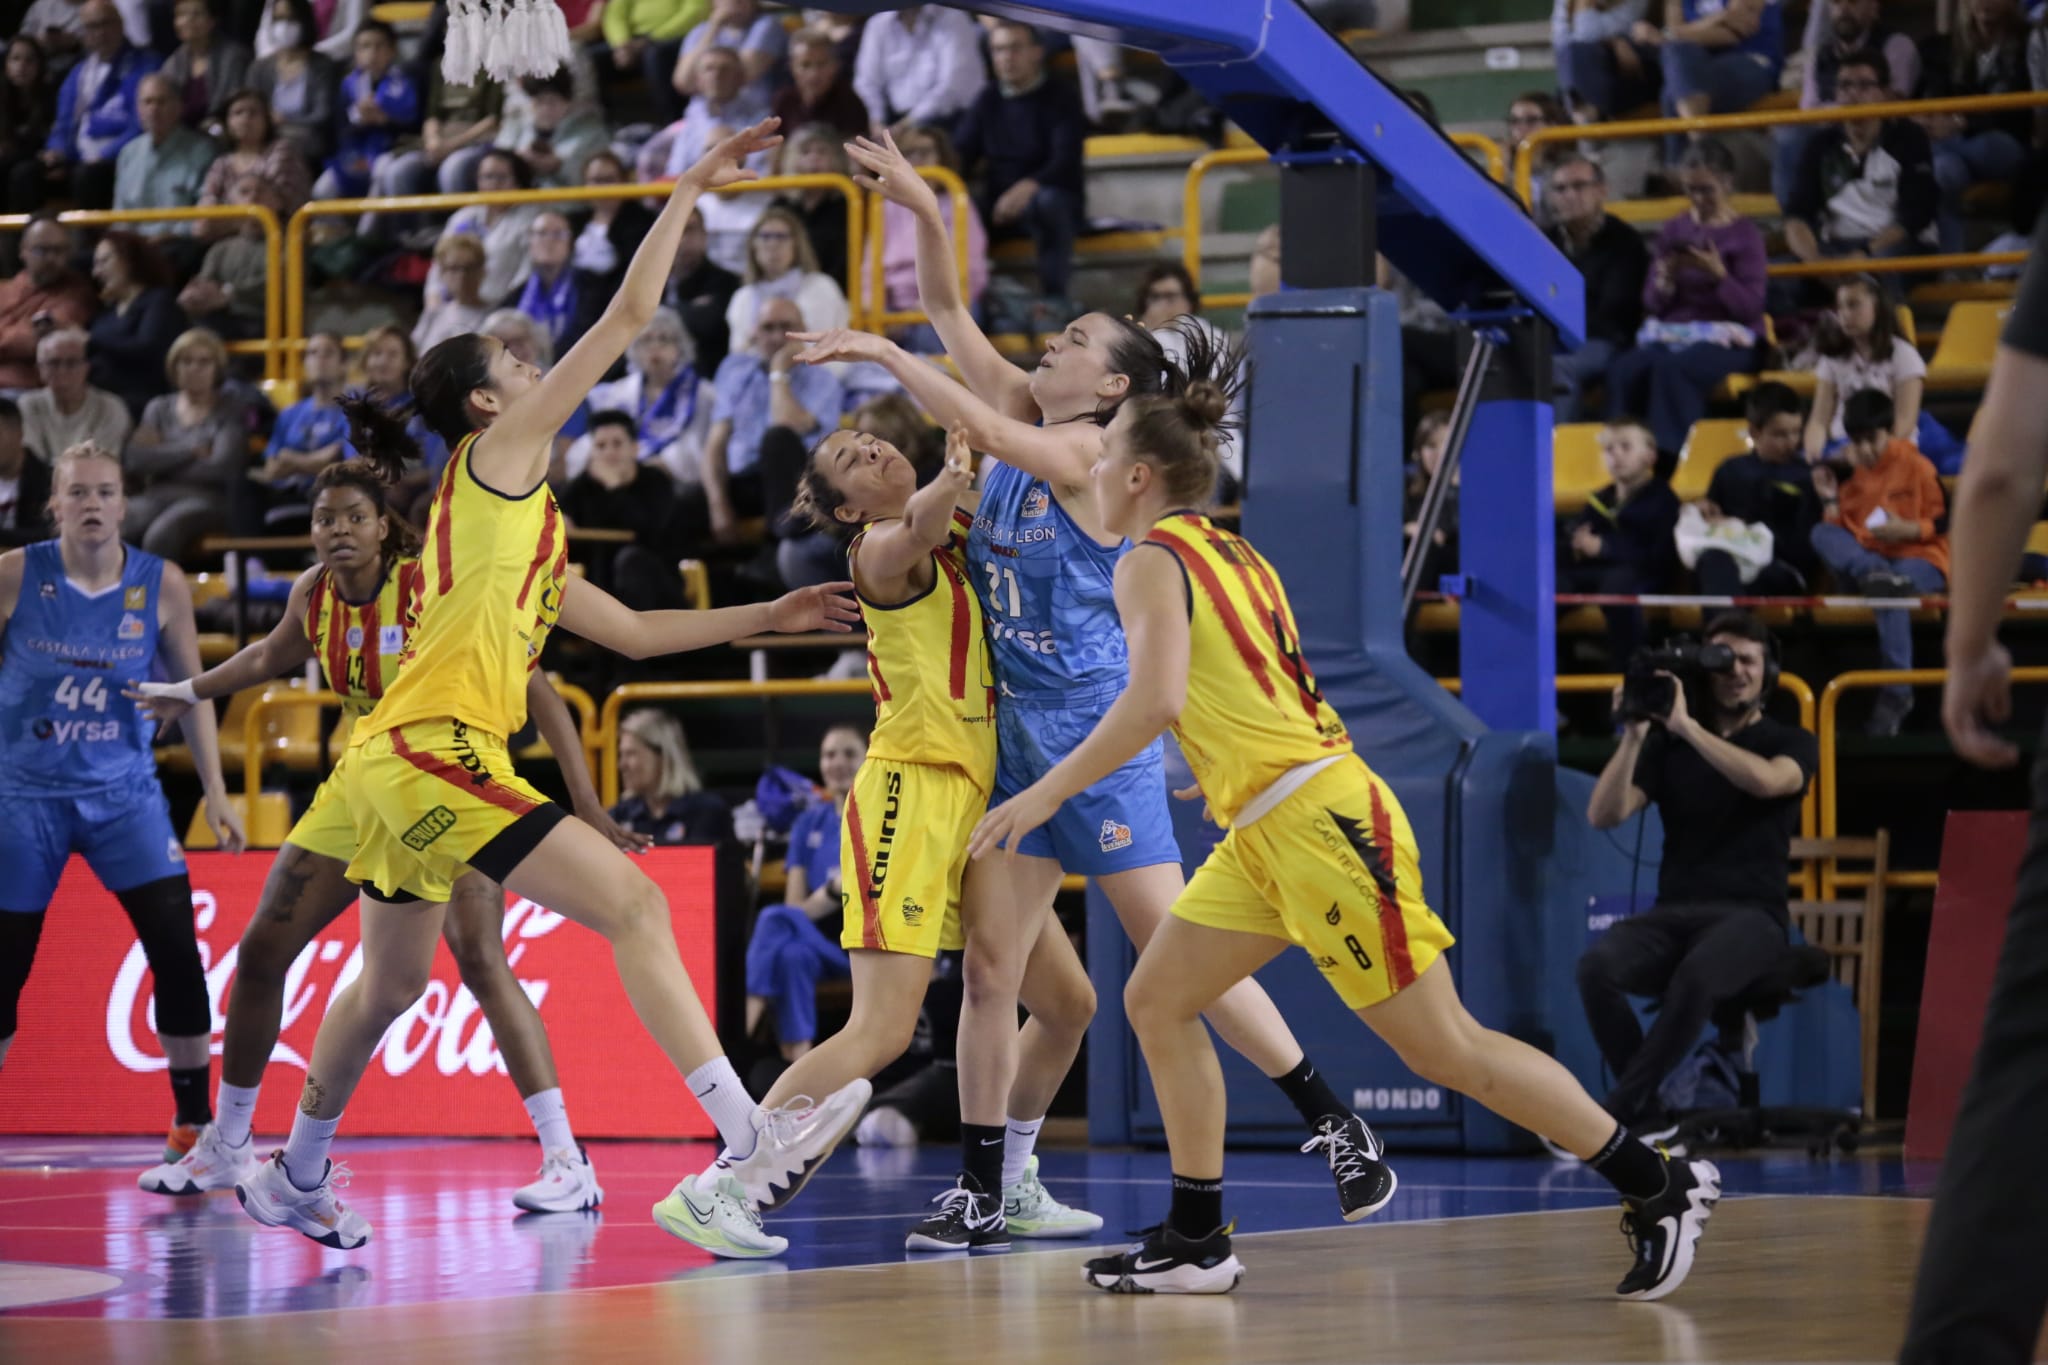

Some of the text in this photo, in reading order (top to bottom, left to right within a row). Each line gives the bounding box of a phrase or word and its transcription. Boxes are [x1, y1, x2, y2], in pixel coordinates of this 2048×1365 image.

[1016, 525, 1056, 543] LEÓN
[55, 674, 108, 713] 44
[52, 719, 120, 746] yrsa
[867, 771, 901, 900] taurus
[1337, 851, 1384, 919] TELECOM
[1344, 934, 1373, 970] 8
[1353, 1087, 1441, 1111] MONDO
